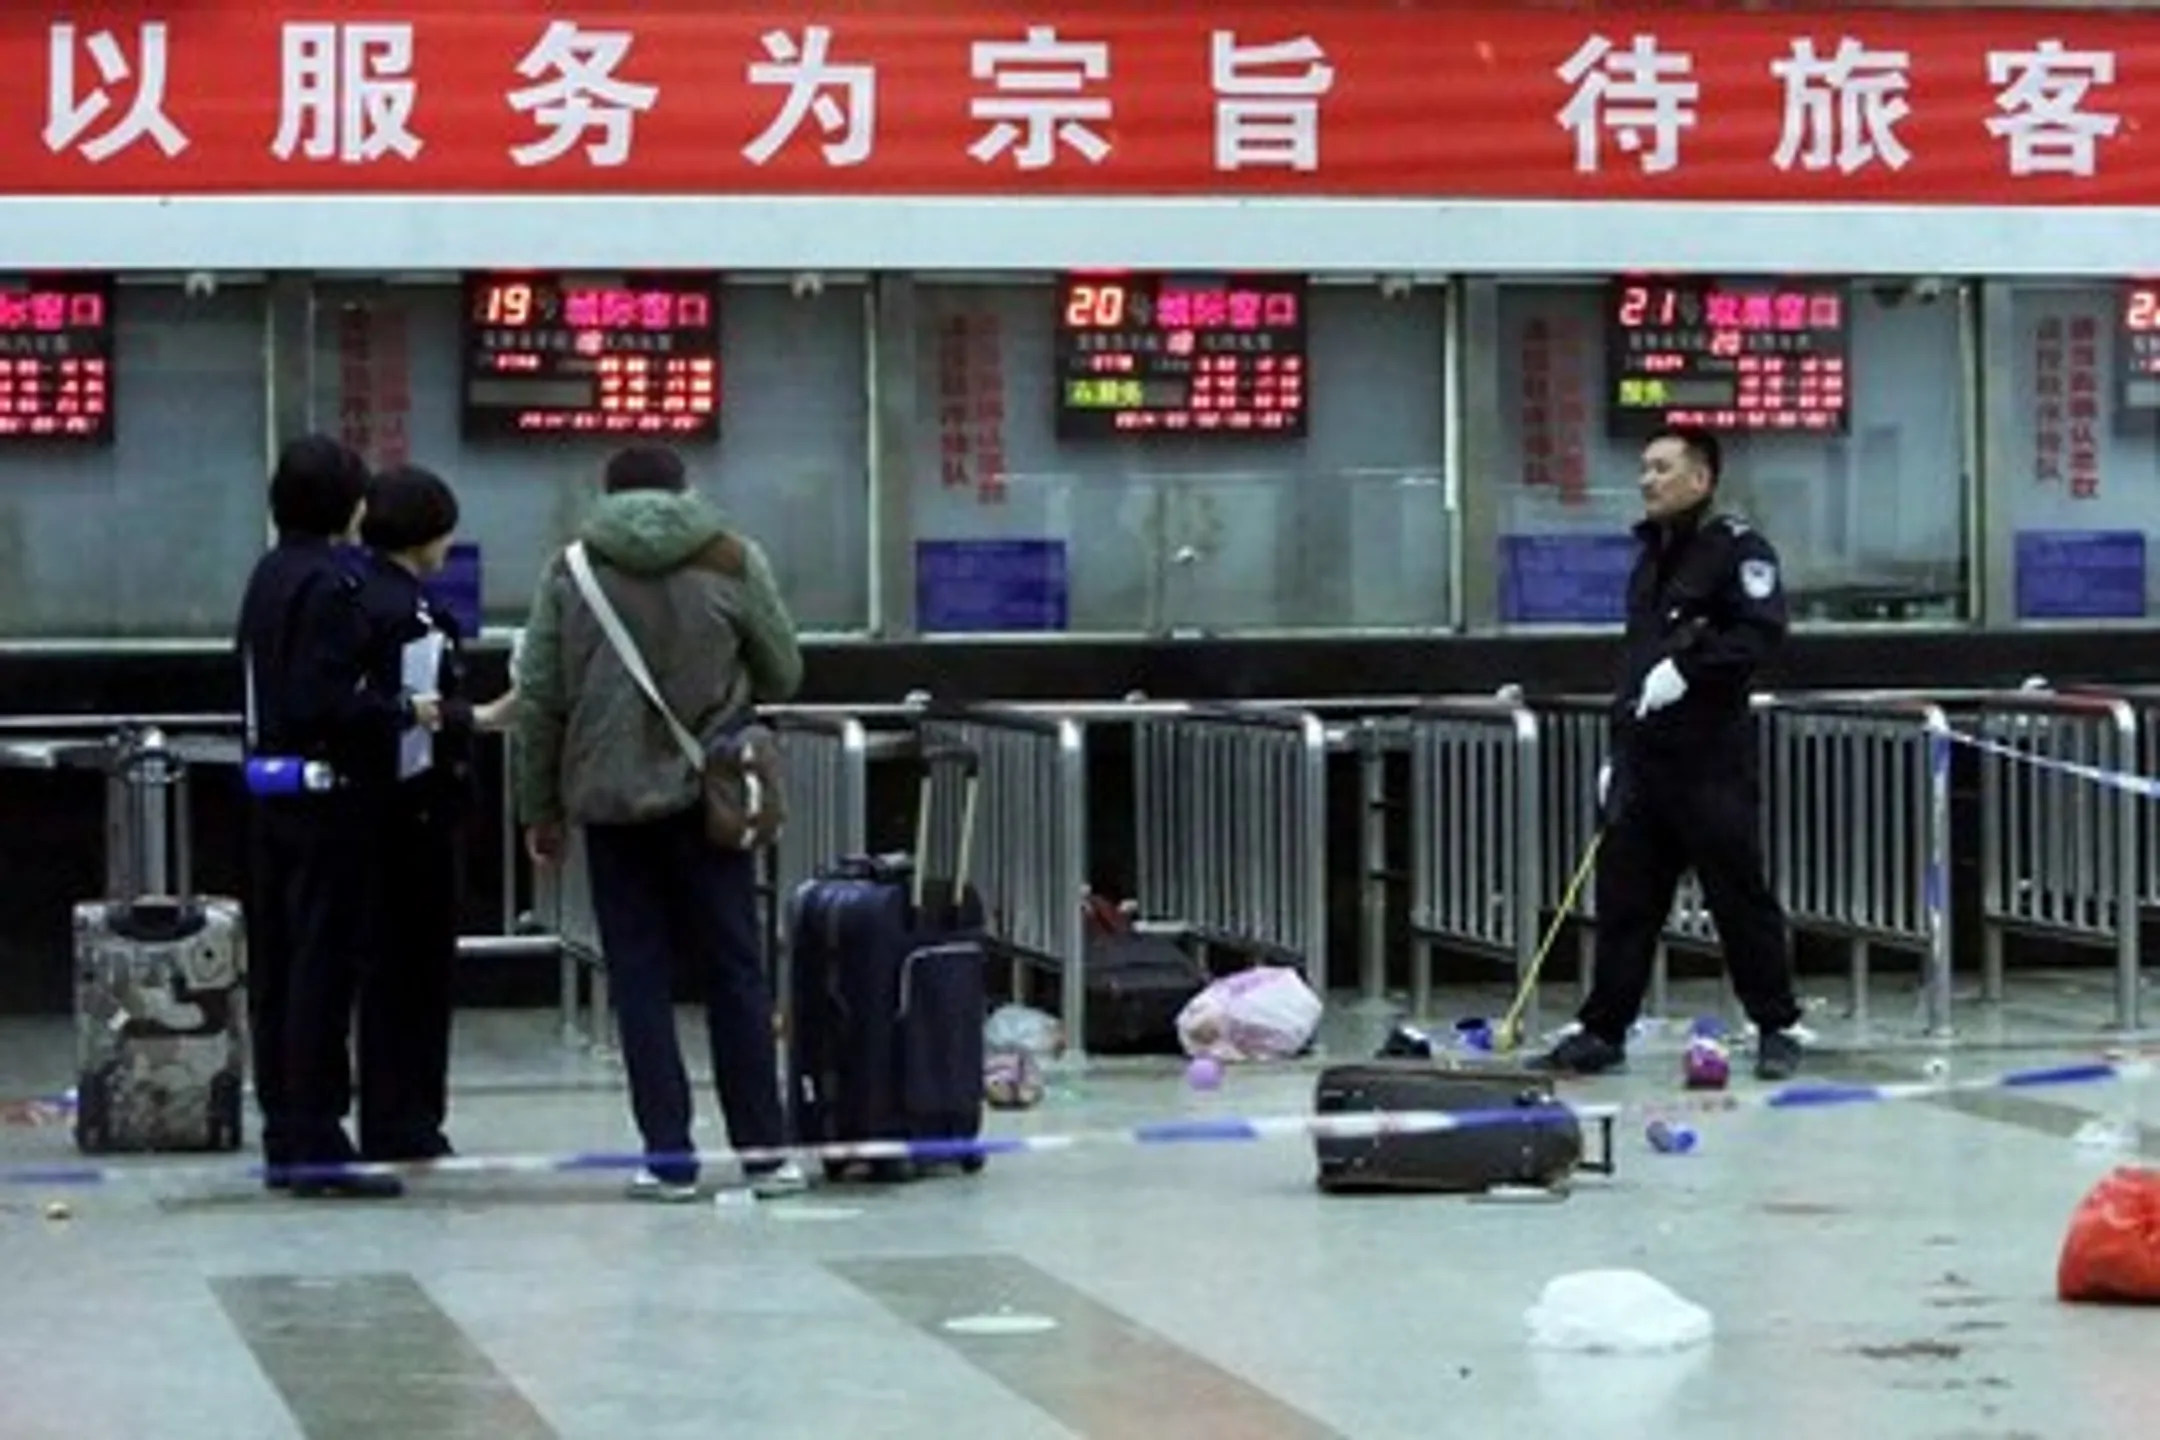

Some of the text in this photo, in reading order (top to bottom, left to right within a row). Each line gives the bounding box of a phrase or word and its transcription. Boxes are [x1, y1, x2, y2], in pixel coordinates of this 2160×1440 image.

[42, 24, 2120, 176] 以服务为宗旨 待旅客
[487, 285, 532, 326] 19
[1066, 286, 1124, 327] 20
[1620, 287, 1676, 326] 21
[2126, 290, 2160, 330] 2
